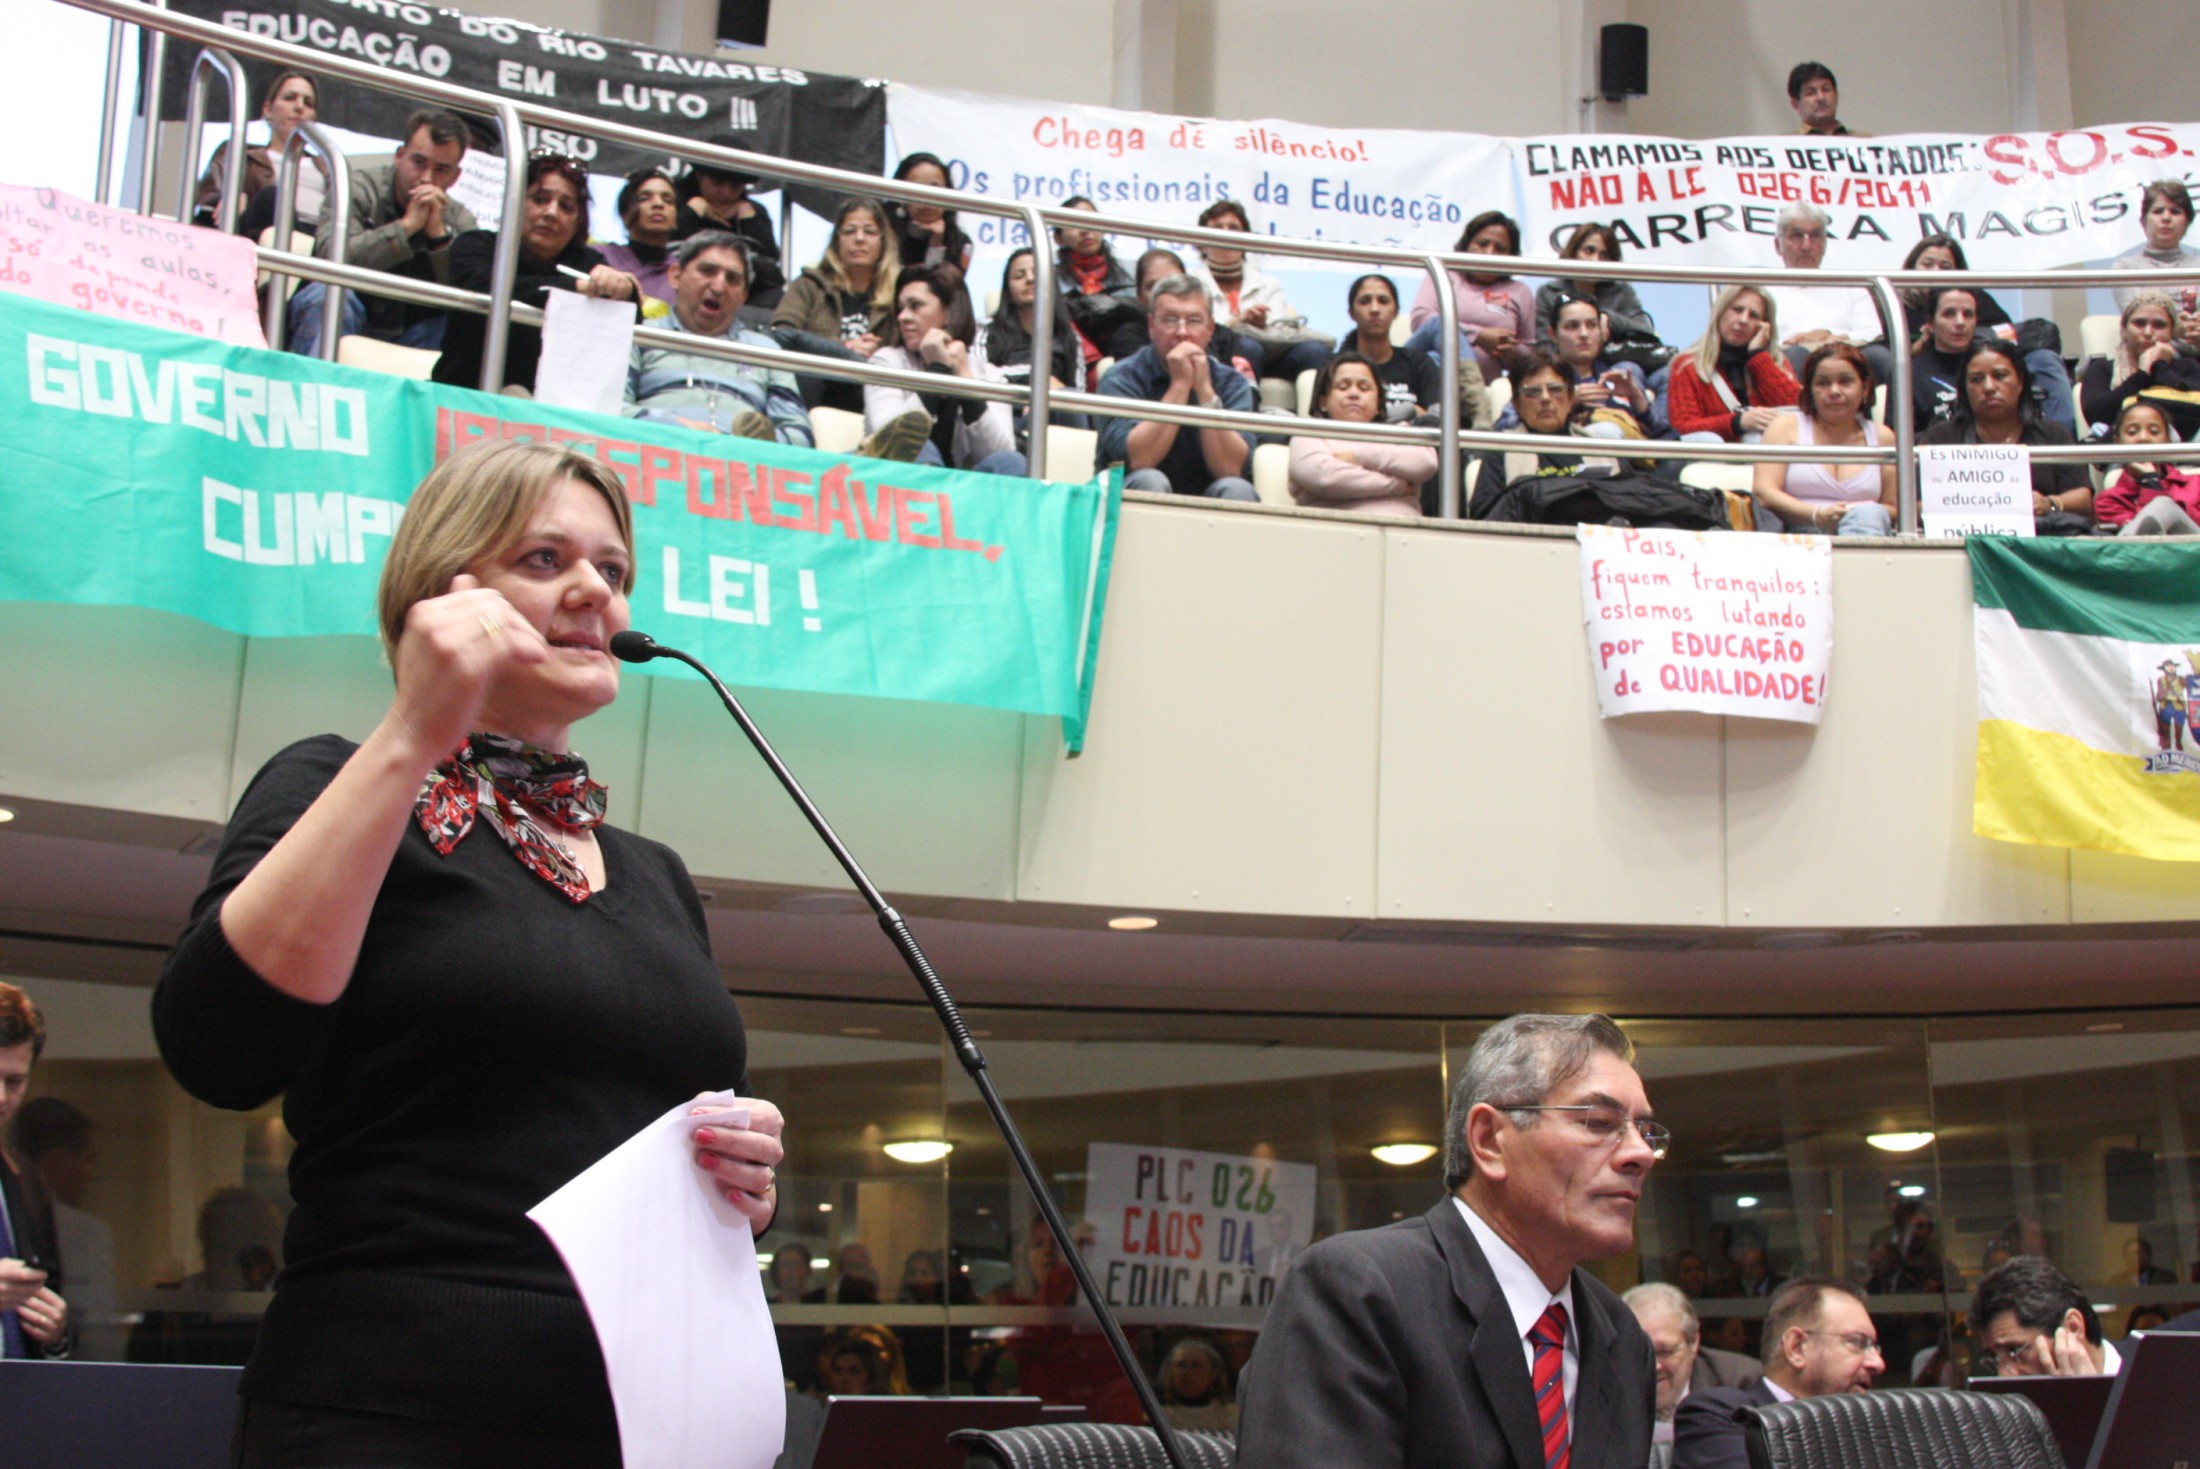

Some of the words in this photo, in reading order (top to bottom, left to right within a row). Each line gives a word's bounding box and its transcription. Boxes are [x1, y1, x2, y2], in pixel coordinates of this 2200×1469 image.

[222, 11, 451, 77] EDUCAÇÃO
[498, 60, 556, 98] EM
[597, 79, 708, 118] LUTO
[460, 16, 519, 44] DO
[538, 32, 607, 61] RIO
[631, 50, 808, 86] TAVARES
[1033, 116, 1145, 158] Chega
[1169, 124, 1206, 149] de
[1234, 128, 1370, 162] silêncio!
[1526, 143, 1703, 176] CLAMAMOS
[1717, 145, 1775, 168] AOS
[1983, 125, 2195, 186] S.O.S.
[946, 159, 989, 194] Os
[1013, 169, 1231, 203] profissionais
[1254, 171, 1289, 207] da
[1312, 178, 1462, 229] Educação
[1550, 171, 1623, 211] NÃO
[33, 187, 195, 250] Queremos
[1549, 204, 1892, 250] CARREA
[0, 255, 32, 285] do
[140, 255, 232, 296] aulas,
[26, 332, 370, 456] GOVERNO
[1947, 470, 2005, 483] AMIGO
[1952, 449, 2019, 461] INIMIGO
[1942, 492, 2012, 508] educação
[202, 475, 406, 565] CUMP
[662, 545, 770, 626] LEI
[1622, 528, 1684, 560] Pais,
[1591, 559, 1671, 605] fiquem
[1691, 562, 1820, 603] tranquilos:
[1601, 591, 1693, 622] estamos
[1722, 599, 1806, 628] lutando
[1600, 638, 1645, 670] por
[1671, 631, 1804, 664] EDUCAÇÃO
[1614, 669, 1642, 697] de
[1659, 663, 1826, 707] QUALIDADE!
[1135, 1154, 1195, 1205] PLC
[1123, 1206, 1204, 1260] CAOS
[1218, 1218, 1255, 1266] DA
